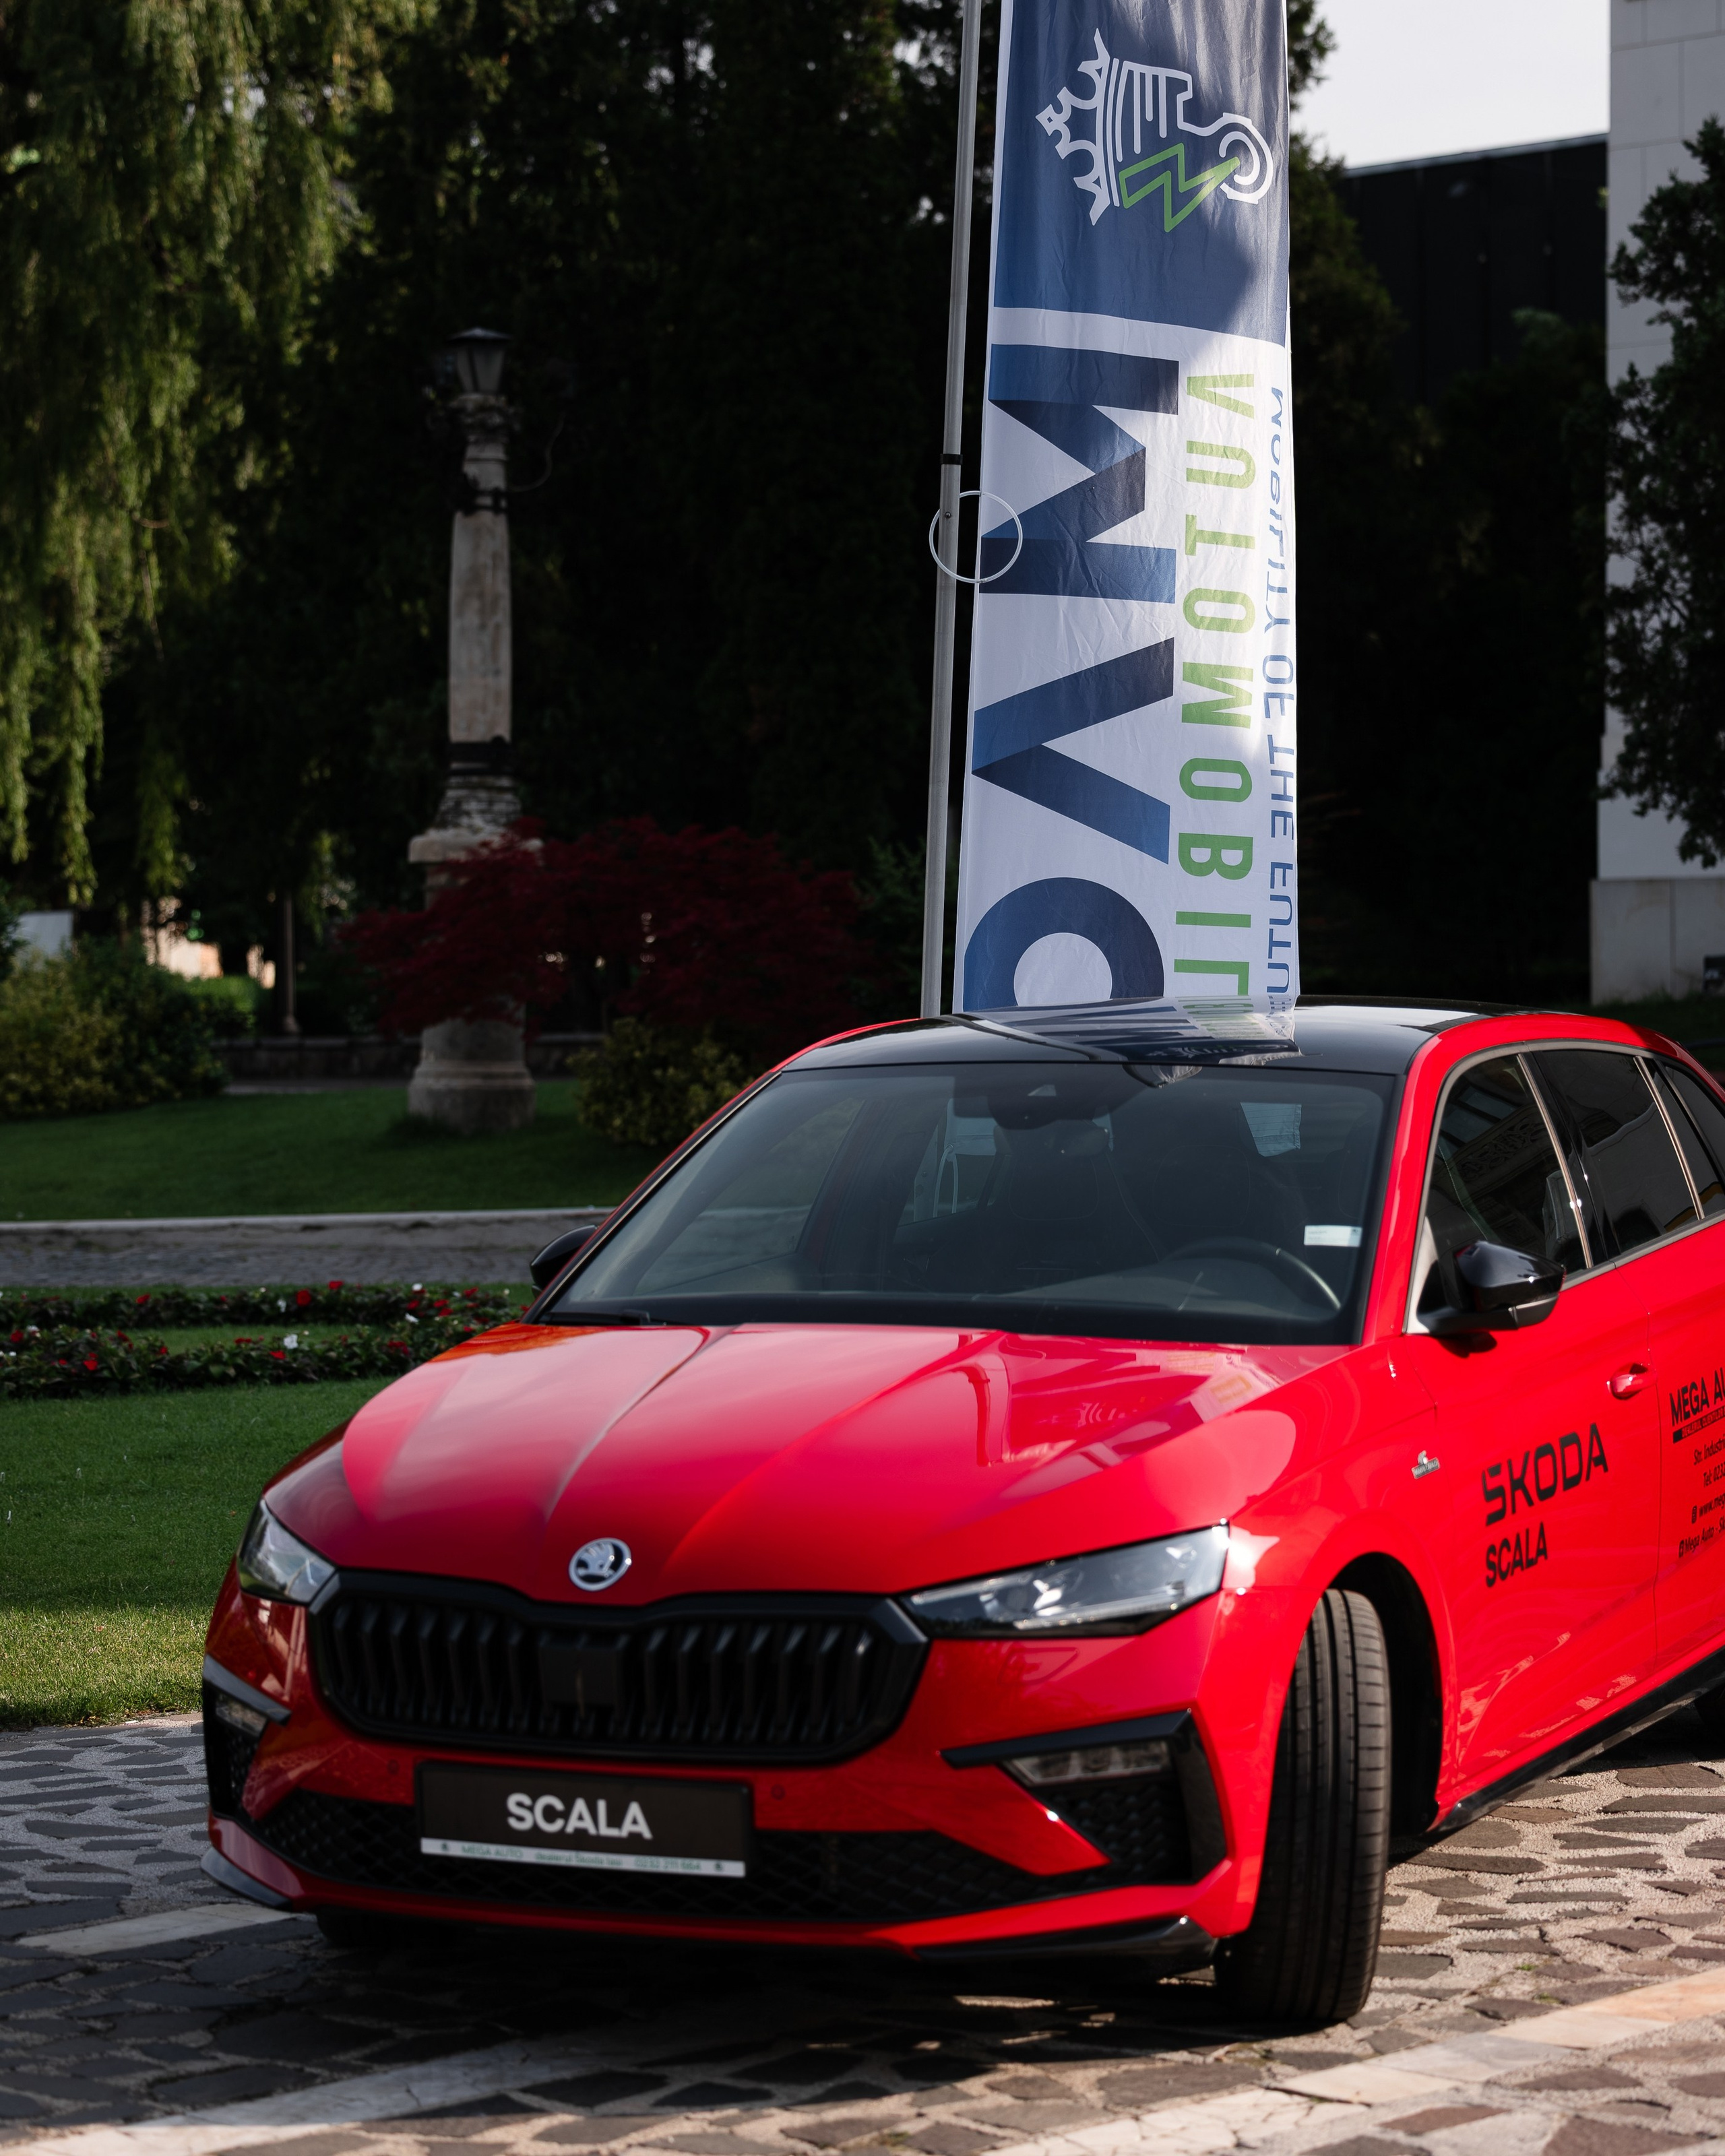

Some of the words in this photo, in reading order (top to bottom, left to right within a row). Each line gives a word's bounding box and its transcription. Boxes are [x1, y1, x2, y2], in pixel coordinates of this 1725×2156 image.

[1669, 1376, 1710, 1427] MEGA
[1486, 1521, 1548, 1588] SCALA
[1685, 1534, 1700, 1553] Mega
[506, 1792, 653, 1840] SCALA
[461, 1844, 492, 1857] MEGA
